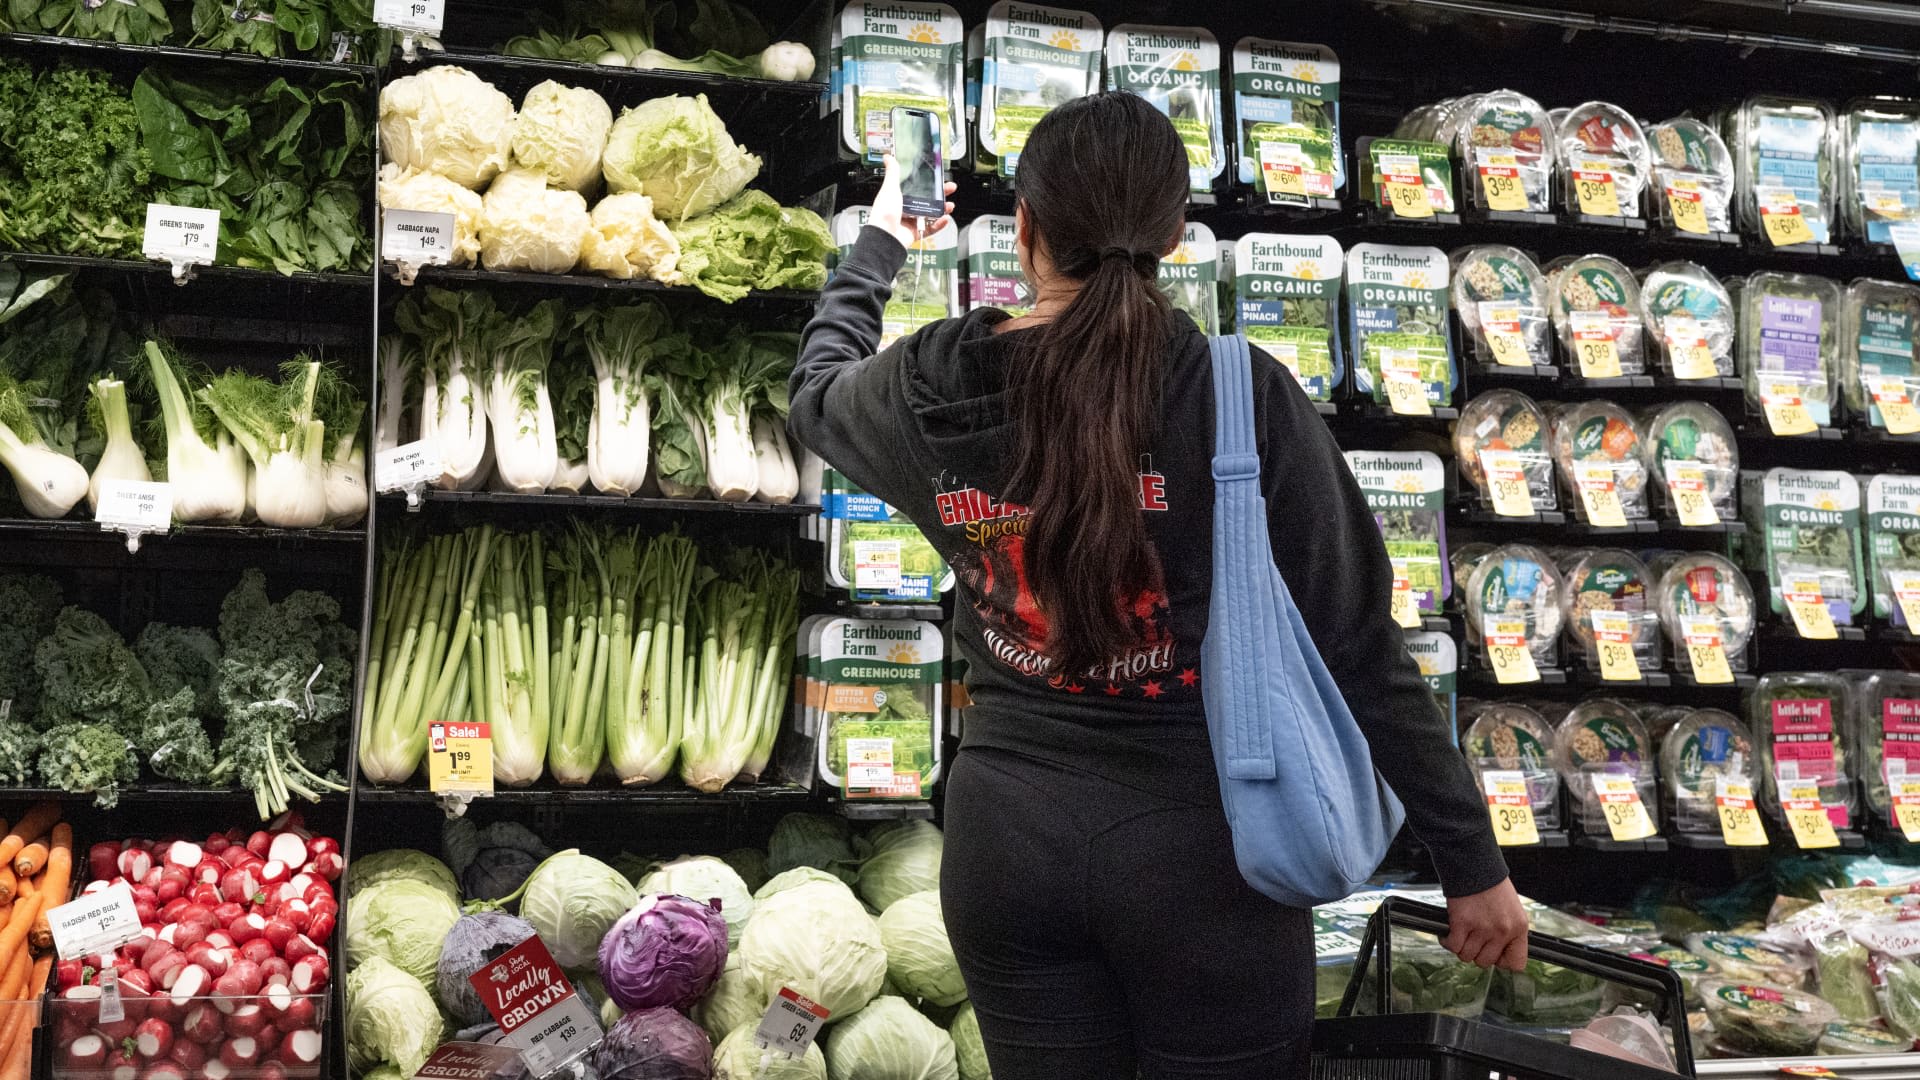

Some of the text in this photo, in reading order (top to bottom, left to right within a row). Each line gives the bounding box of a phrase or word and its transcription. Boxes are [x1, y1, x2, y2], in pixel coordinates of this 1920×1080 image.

[411, 4, 425, 17] 199
[863, 4, 941, 22] Earthbound
[1008, 6, 1083, 29] Earthbound
[863, 19, 897, 33] Farm
[1007, 20, 1040, 38] Farm
[1127, 32, 1200, 49] Earthbound
[864, 43, 942, 59] GREENHOUSE
[1006, 45, 1081, 66] GREENHOUSE
[1127, 49, 1159, 63] Farm
[1250, 43, 1320, 62] Earthbound
[1251, 57, 1282, 72] Farm
[1127, 73, 1201, 86] ORGANIC
[1251, 79, 1321, 97] ORGANIC
[1488, 177, 1513, 197] 399
[1581, 181, 1607, 201] 399
[1674, 198, 1697, 217] 399
[160, 220, 204, 230] GREENS TURNIP
[397, 223, 440, 234] CABBAGE NAPA
[184, 233, 199, 246] 179
[420, 236, 435, 248] 149
[1251, 241, 1323, 259] Earthbound
[1251, 258, 1283, 272] Farm
[1362, 252, 1431, 269] Earthbound
[1363, 268, 1393, 281] Farm
[984, 281, 1011, 289] SPRING
[1250, 280, 1323, 294] ORGANIC
[1363, 288, 1433, 303] ORGANIC
[1494, 335, 1518, 354] 399
[1584, 344, 1609, 365] 399
[406, 452, 420, 461] CHOY
[1354, 457, 1422, 472] Earthbound
[1494, 480, 1519, 500] 399
[1778, 474, 1840, 490] Earthbound
[1881, 482, 1920, 496] Earthbo
[1368, 494, 1426, 507] RGANIC
[1587, 491, 1612, 512] 399
[1681, 493, 1704, 513] 399
[1780, 488, 1806, 502] Farm
[847, 504, 880, 512] CRUNCH
[1882, 497, 1908, 510] Farm
[1780, 509, 1843, 524] ORGANIC
[1881, 517, 1920, 530] ORGA
[842, 624, 922, 641] Earthbound
[842, 640, 876, 655] Farm
[1110, 640, 1176, 682] Hot!
[1495, 646, 1520, 668] 399
[1604, 645, 1628, 667] 399
[1693, 647, 1716, 667] 399
[841, 667, 921, 679] GREENHOUSE
[834, 689, 864, 697] BUTTER
[834, 696, 868, 705] LETTUCE
[1777, 703, 1824, 717] little leaf
[449, 726, 480, 738] Sale!
[450, 752, 471, 769] 199
[1499, 809, 1527, 831] 399
[1608, 804, 1635, 825] 399
[1725, 808, 1750, 830] 399
[62, 901, 121, 930] RADISH RED BULK
[511, 959, 531, 975] LOCAL
[496, 965, 551, 1010] Locally
[501, 979, 567, 1029] GROWN
[781, 1001, 816, 1023] GREEN CABBAGE
[530, 1015, 572, 1046] RED CABBAGE
[559, 1026, 577, 1043] 139
[421, 1065, 491, 1079] GROWN
